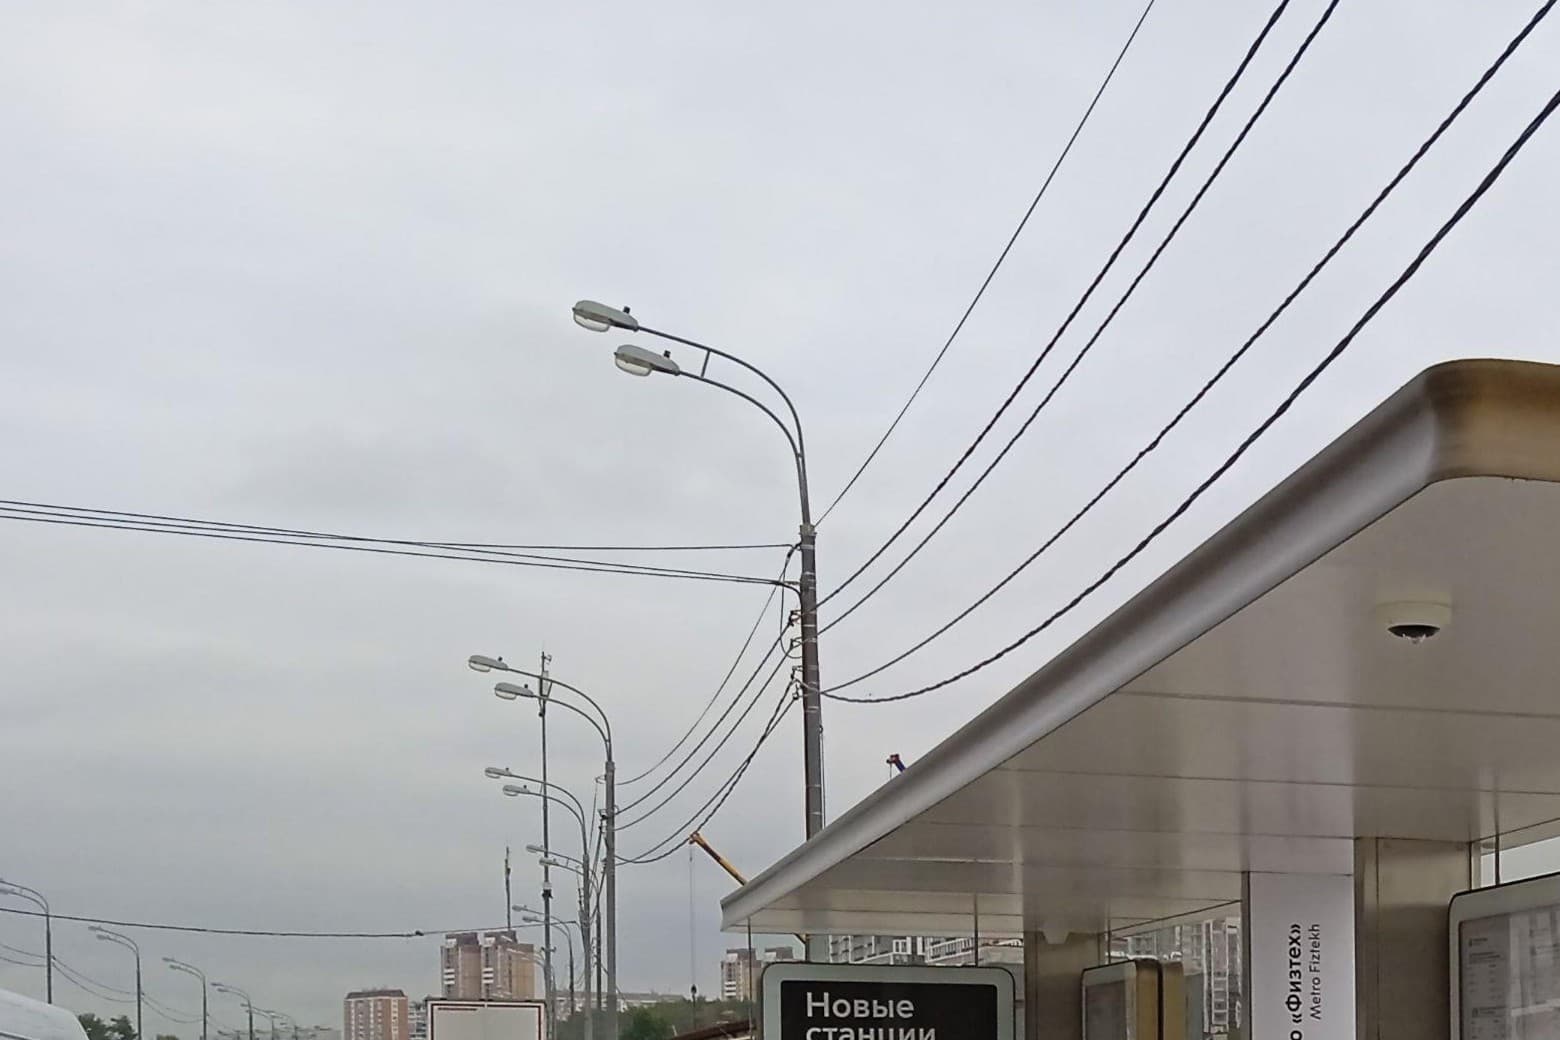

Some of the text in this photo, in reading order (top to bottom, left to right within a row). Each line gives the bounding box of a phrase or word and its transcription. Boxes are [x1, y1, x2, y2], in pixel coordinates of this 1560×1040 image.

[806, 991, 915, 1019] Новые
[1285, 923, 1303, 1024] «Физтех»
[1308, 923, 1322, 1020] Metro Fiztekh
